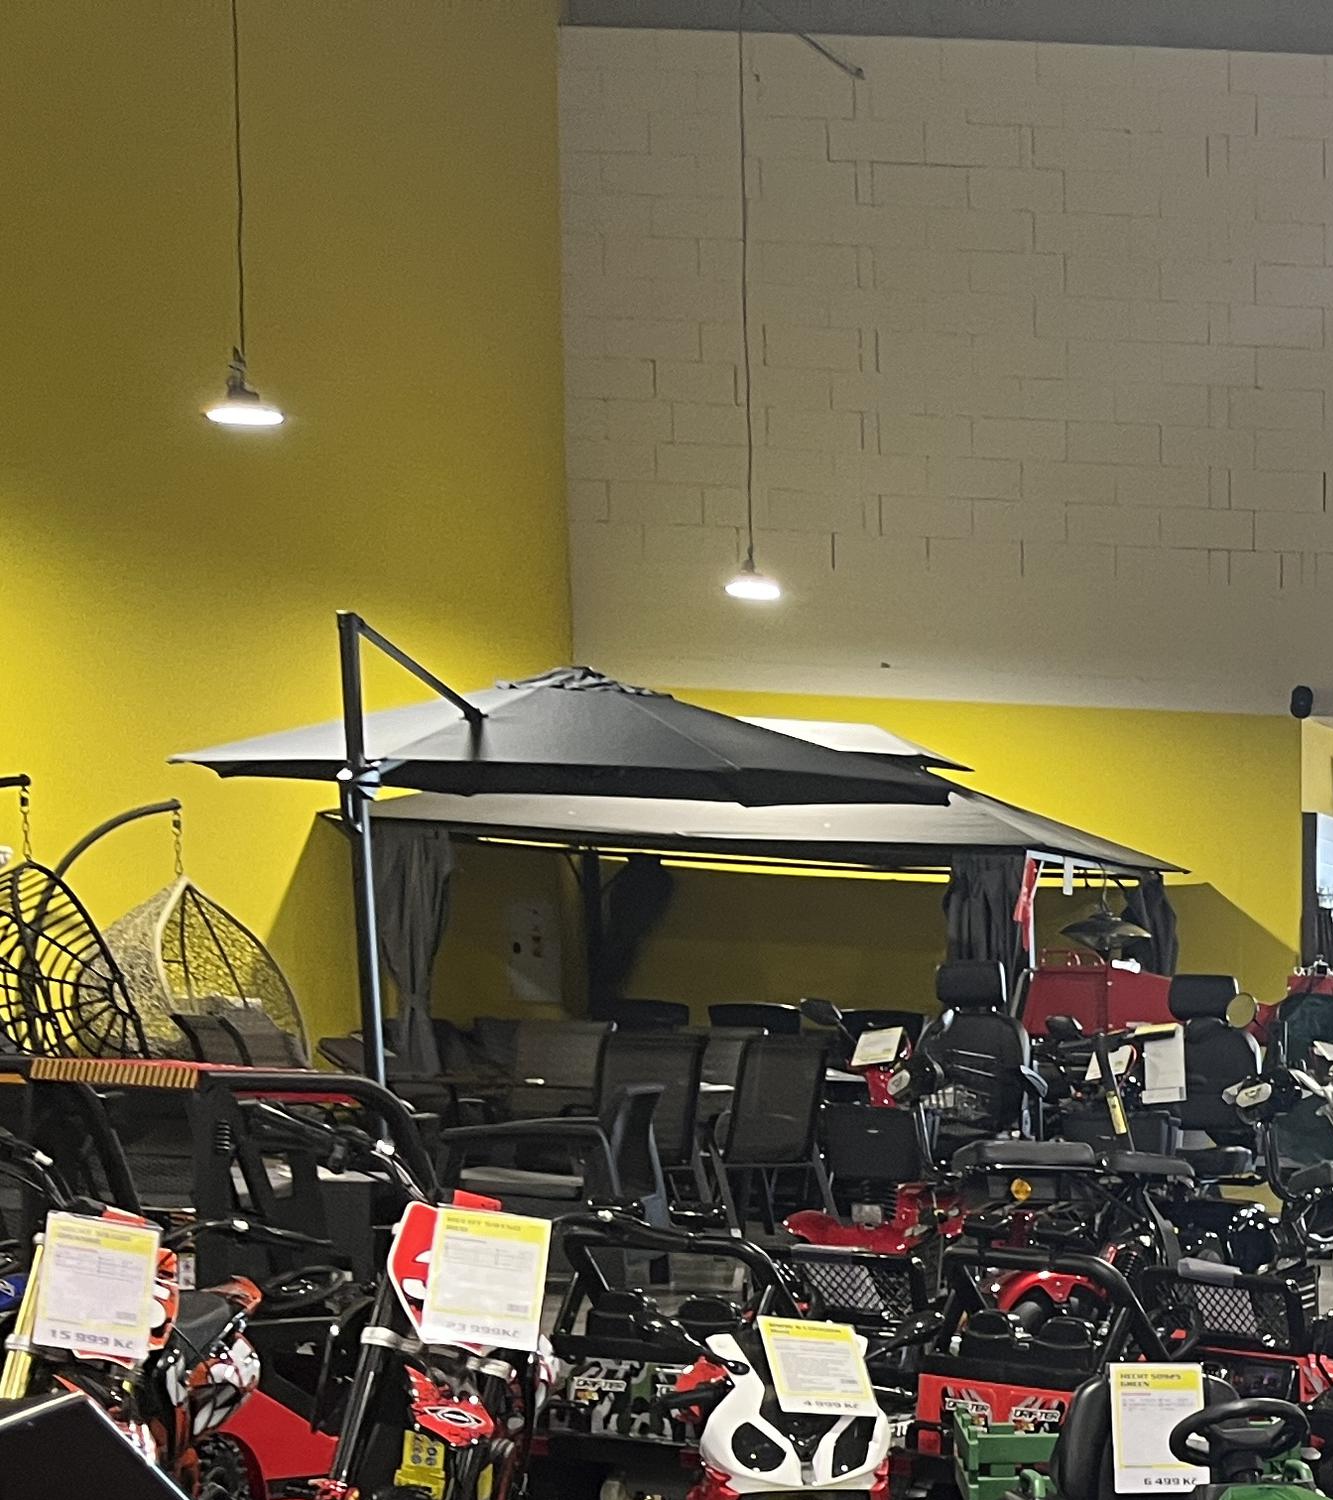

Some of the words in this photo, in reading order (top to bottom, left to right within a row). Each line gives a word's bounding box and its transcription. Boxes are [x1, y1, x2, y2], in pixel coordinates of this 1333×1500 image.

[1014, 1409, 1059, 1421] DRIFTER
[1144, 1477, 1152, 1485] 6
[1155, 1477, 1179, 1485] 499
